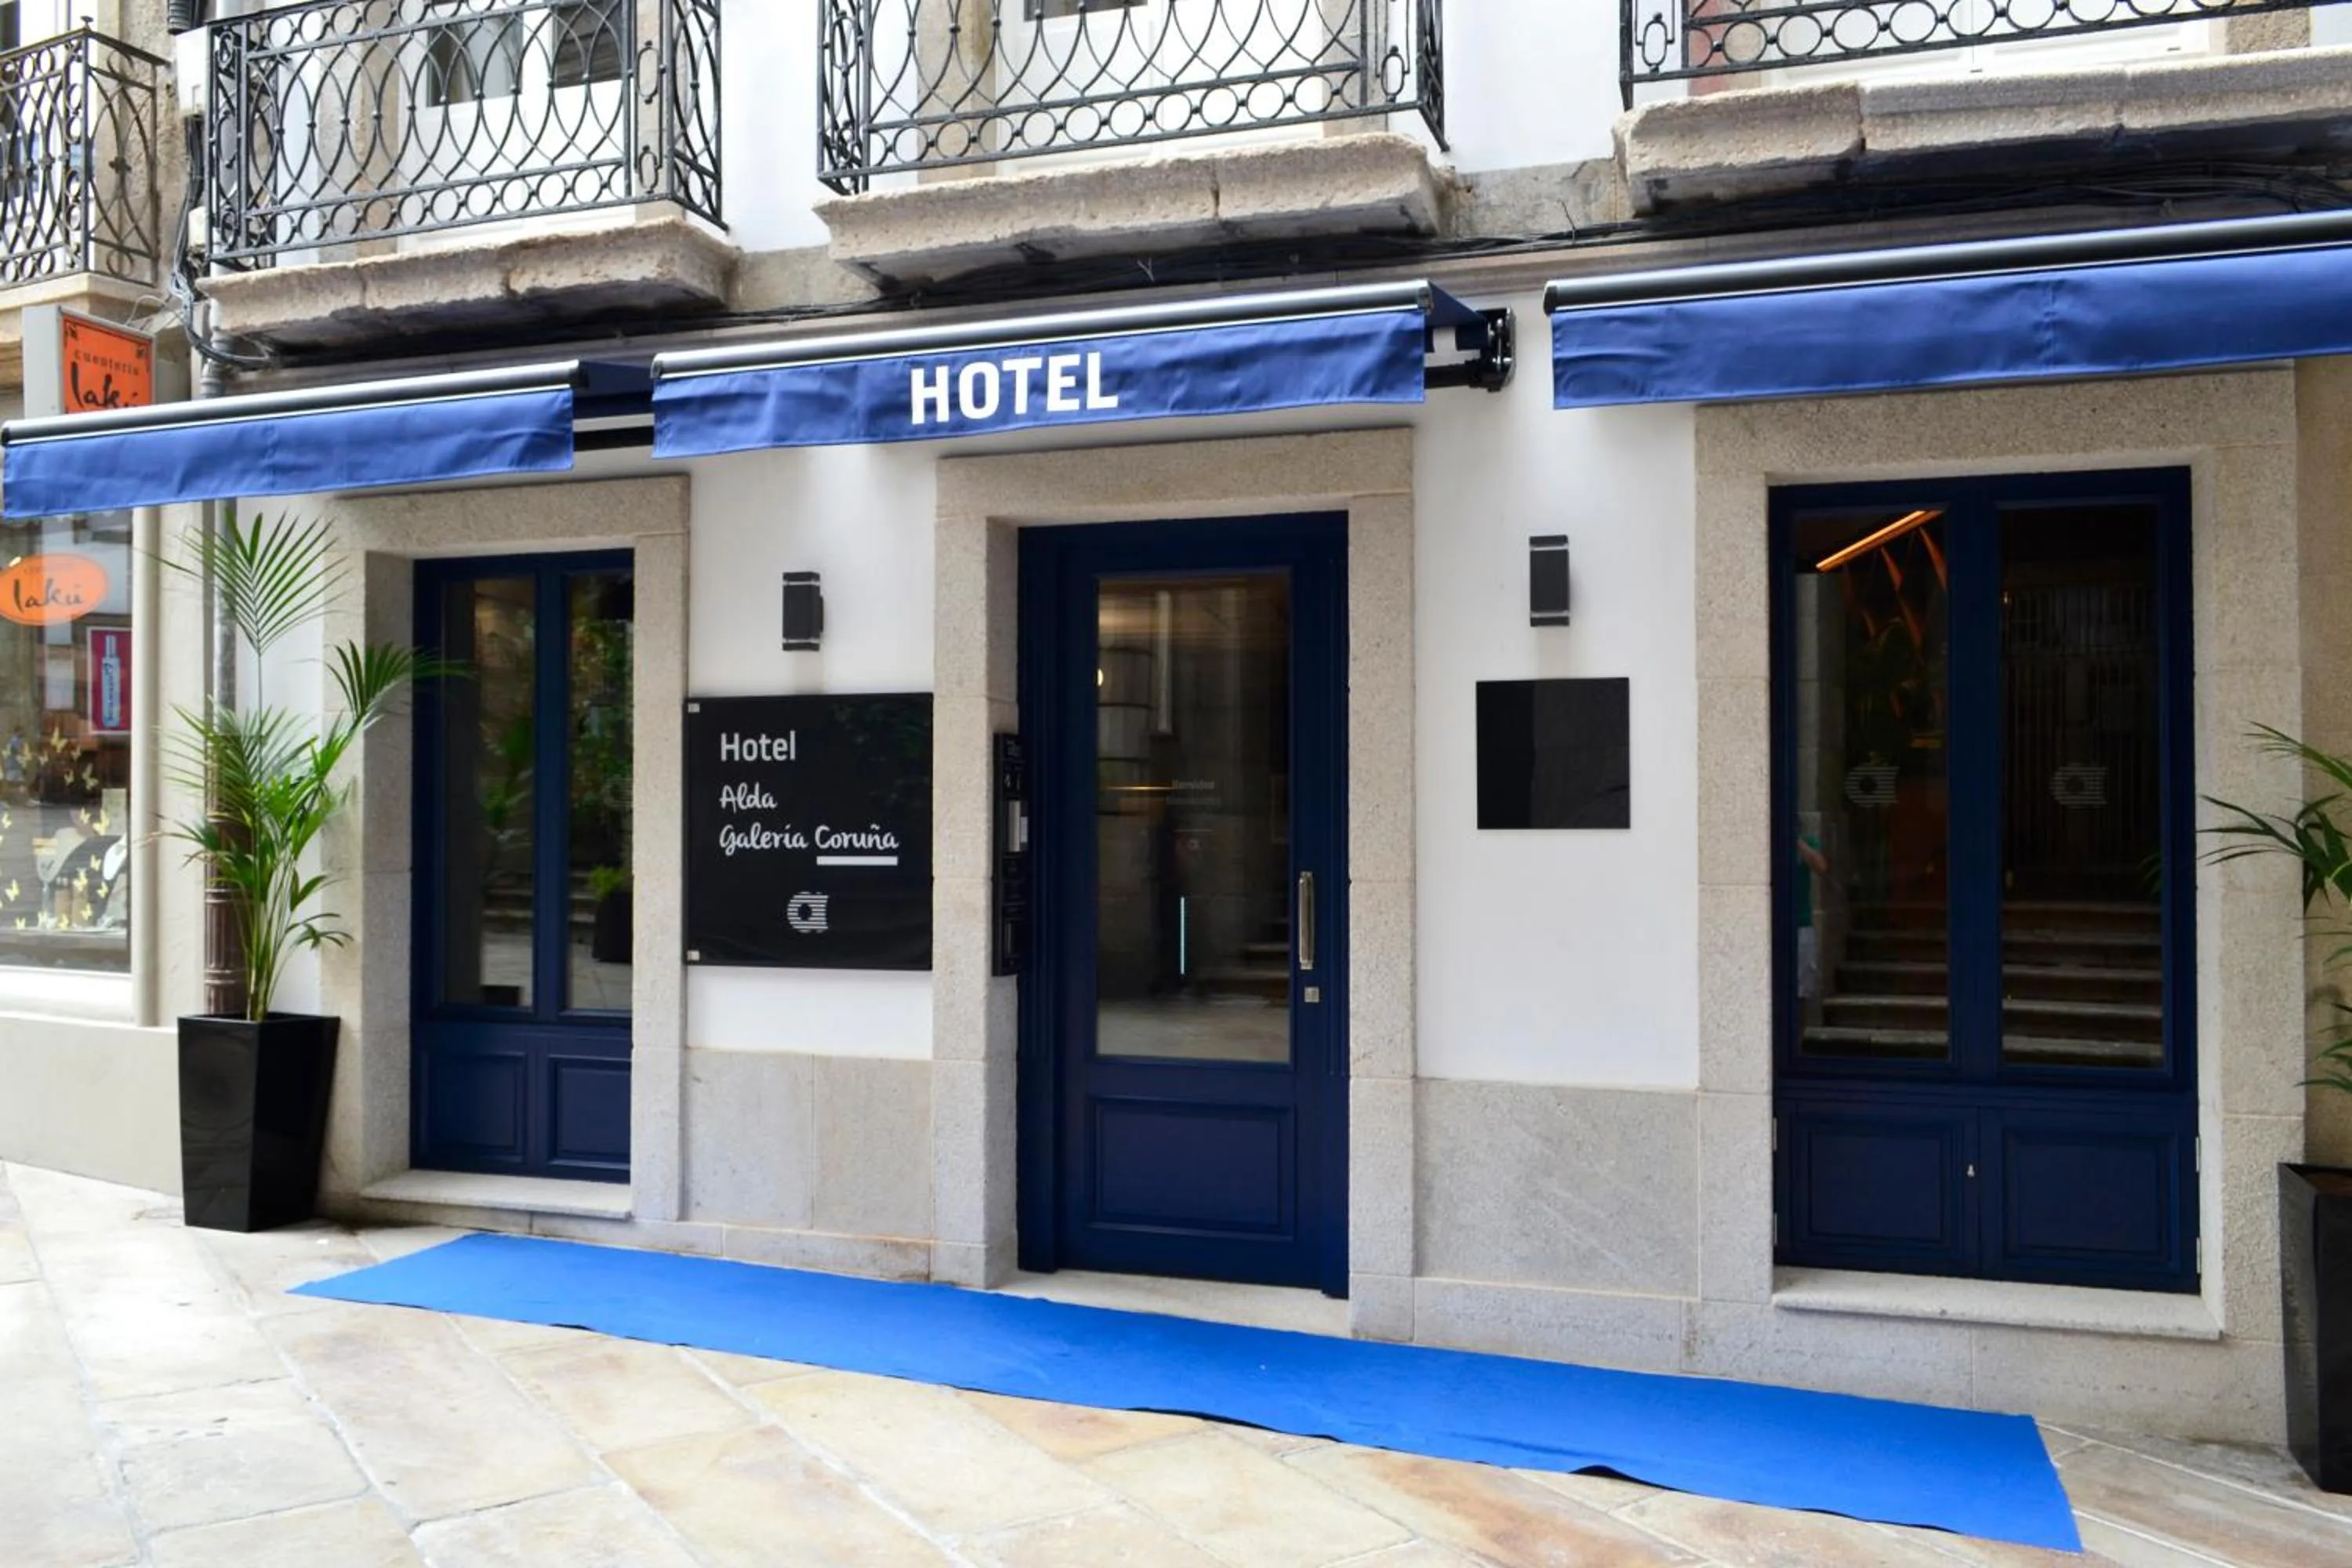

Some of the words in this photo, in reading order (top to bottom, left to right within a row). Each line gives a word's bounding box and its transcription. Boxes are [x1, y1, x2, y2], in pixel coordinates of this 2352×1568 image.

[910, 351, 1119, 426] HOTEL
[720, 730, 797, 762] Hotel
[719, 782, 778, 814] Alda
[719, 822, 809, 856] Galería
[815, 823, 900, 851] Coruña
